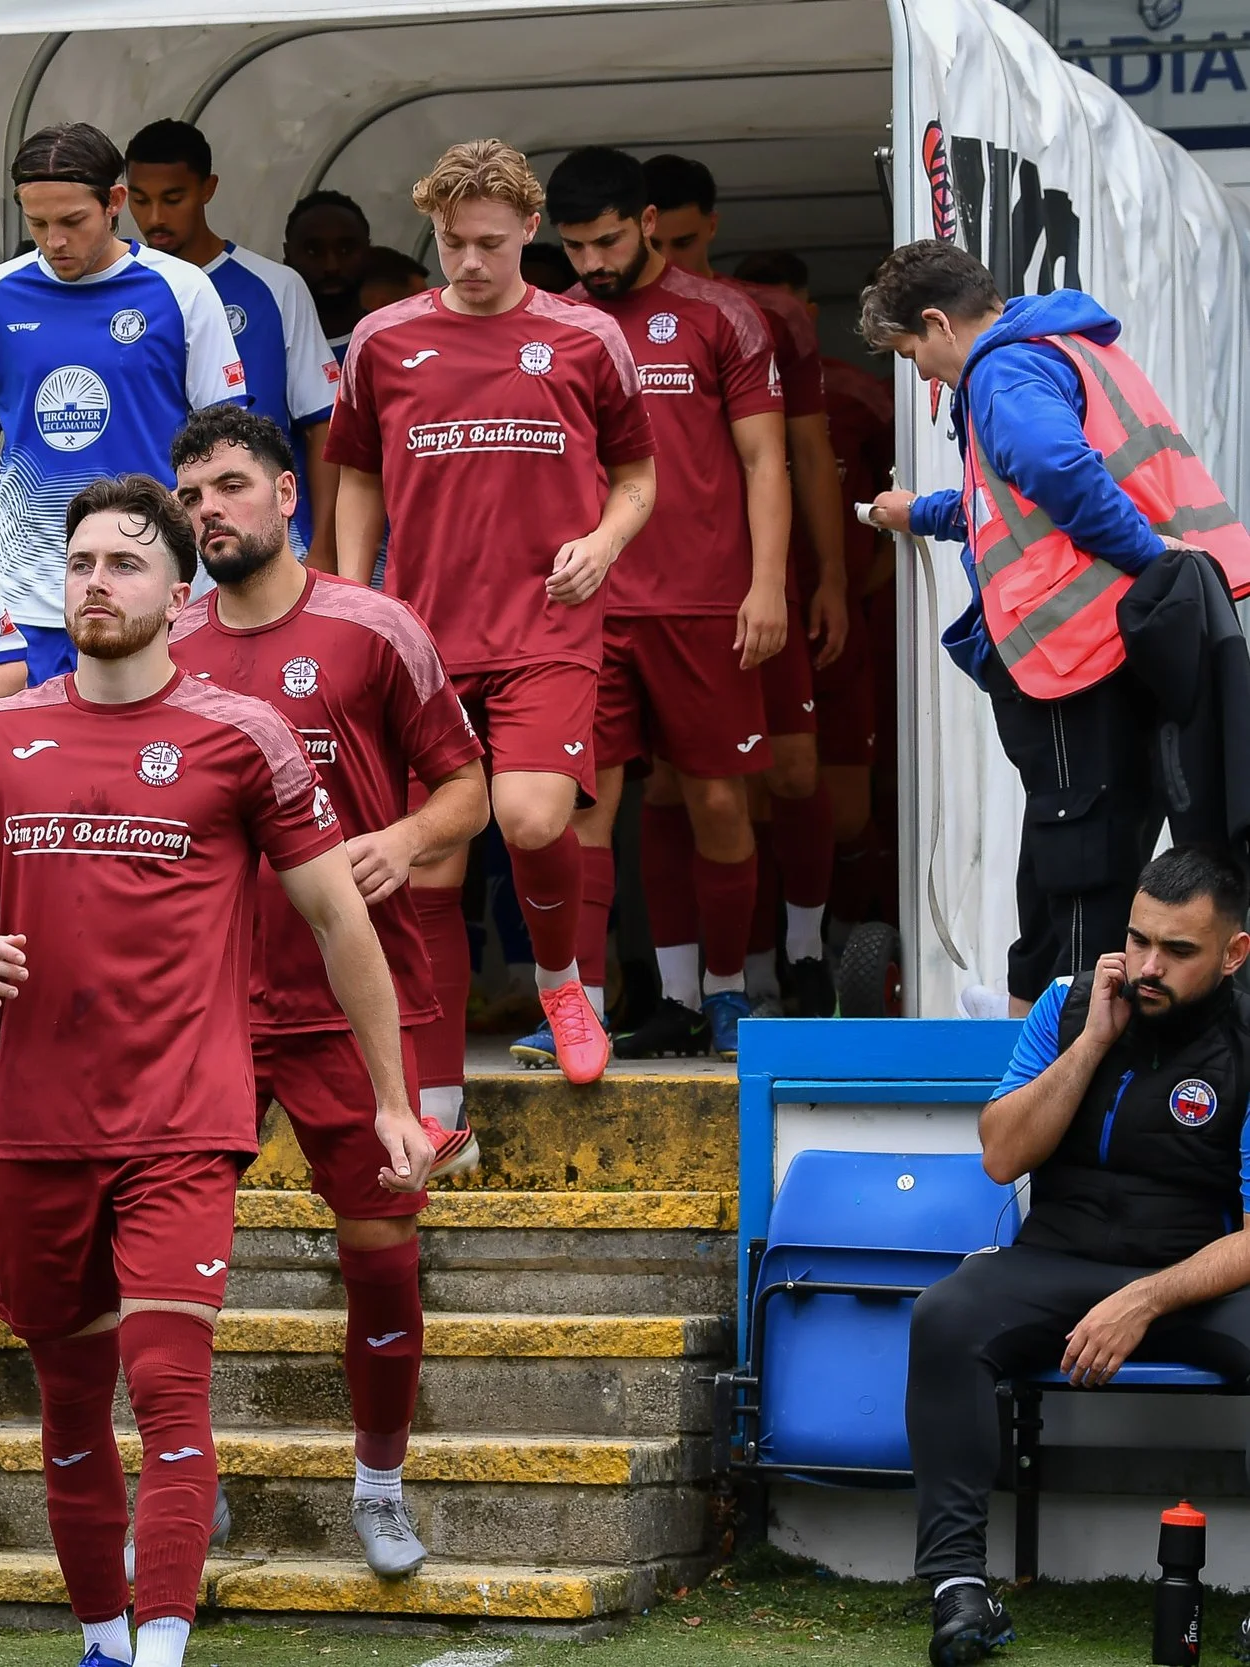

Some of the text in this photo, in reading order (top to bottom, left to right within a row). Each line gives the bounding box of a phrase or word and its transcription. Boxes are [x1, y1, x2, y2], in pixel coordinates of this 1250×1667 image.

[1066, 30, 1250, 97] DIA
[639, 368, 695, 394] hrooms
[43, 410, 101, 422] BIRCHOVER
[43, 421, 101, 431] RECLAMATION
[406, 423, 566, 455] Simply Bathrooms
[3, 816, 191, 860] Simply Bathrooms
